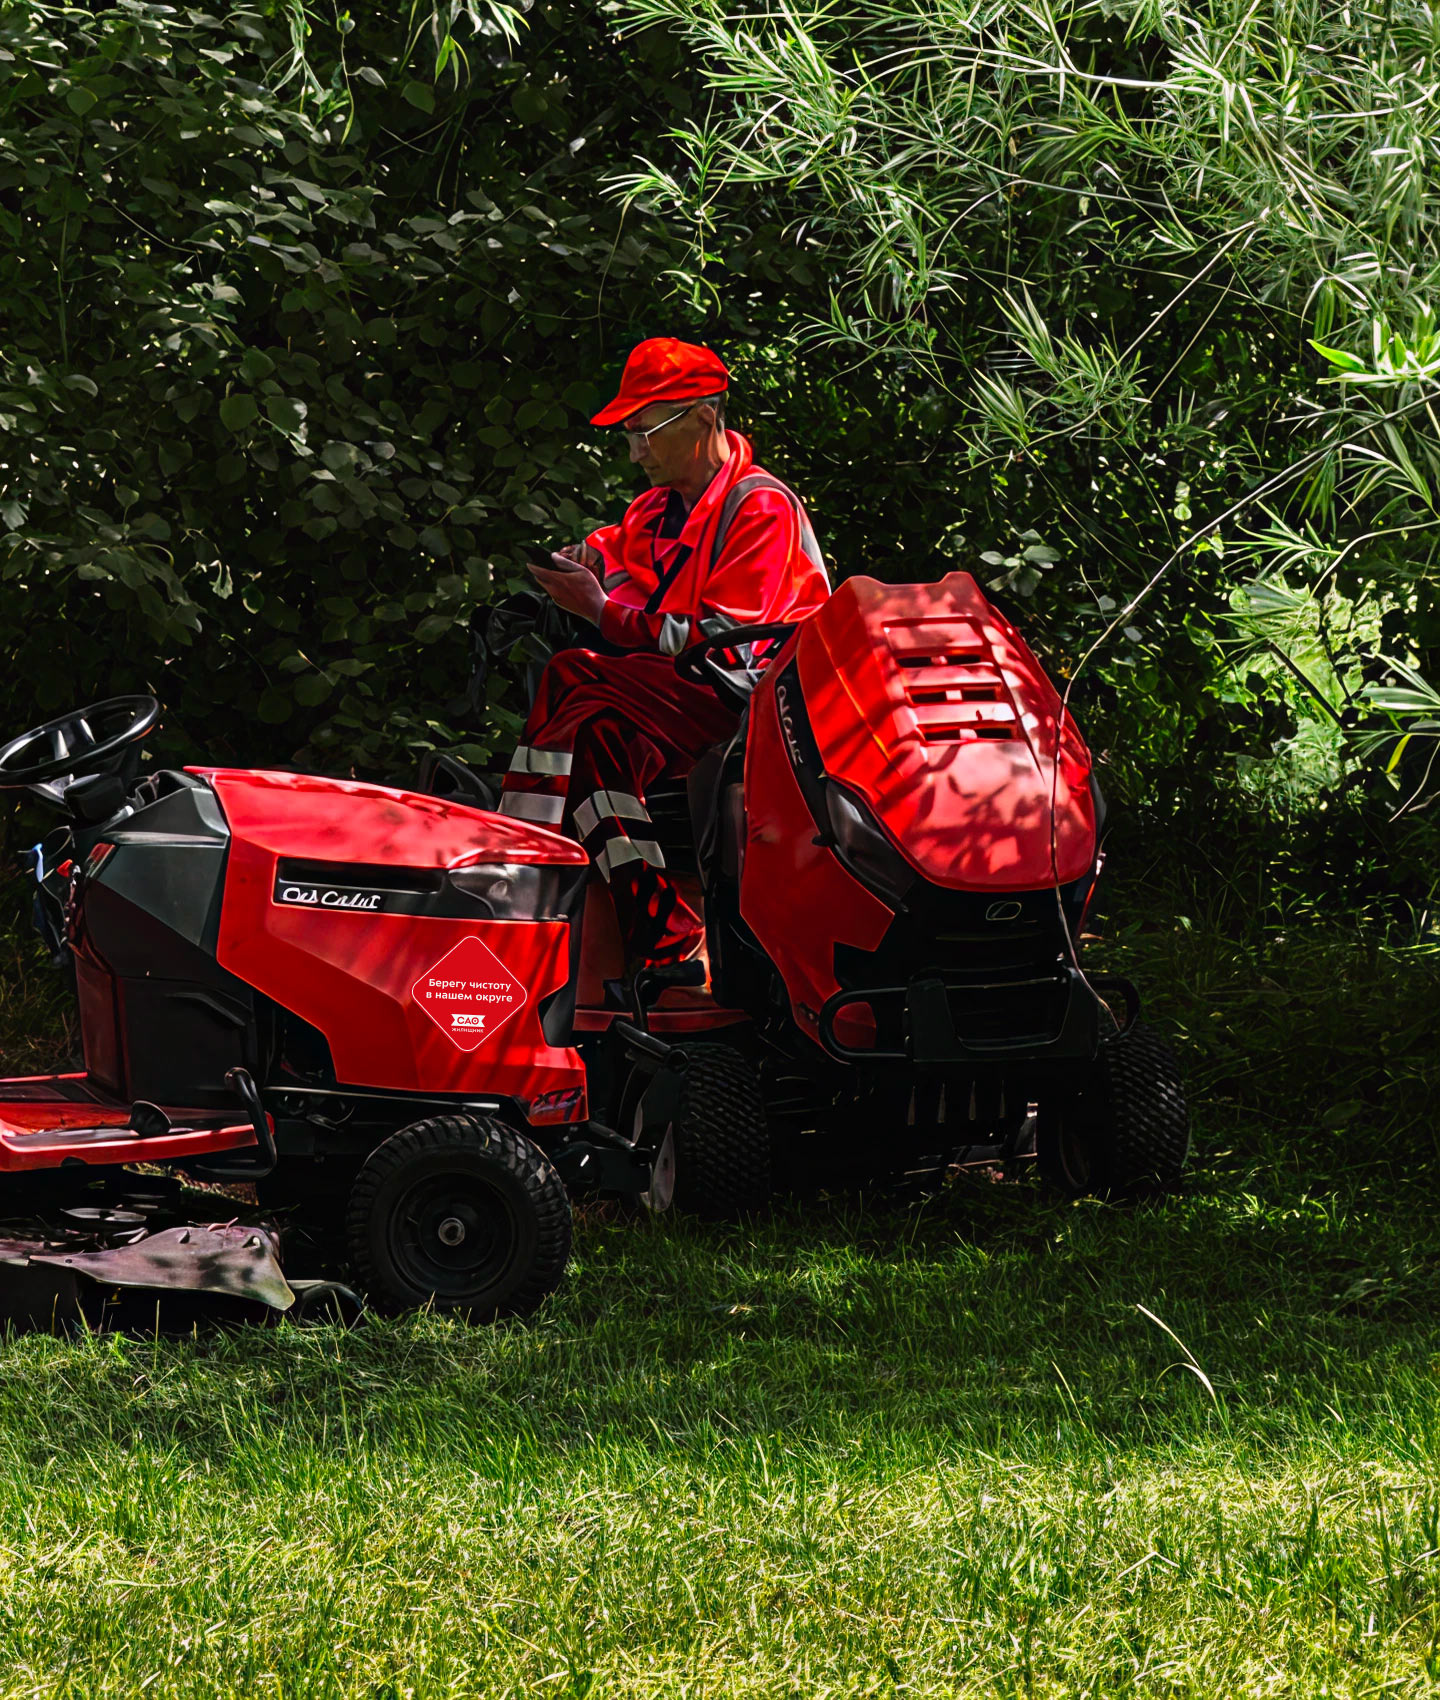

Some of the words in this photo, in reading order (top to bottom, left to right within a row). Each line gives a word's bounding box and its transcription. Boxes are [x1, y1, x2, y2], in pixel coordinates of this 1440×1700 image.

[428, 978, 467, 990] Берегу
[469, 982, 512, 992] чистоту
[425, 991, 432, 999] в
[435, 992, 473, 1000] нашем
[475, 994, 513, 1003] округе
